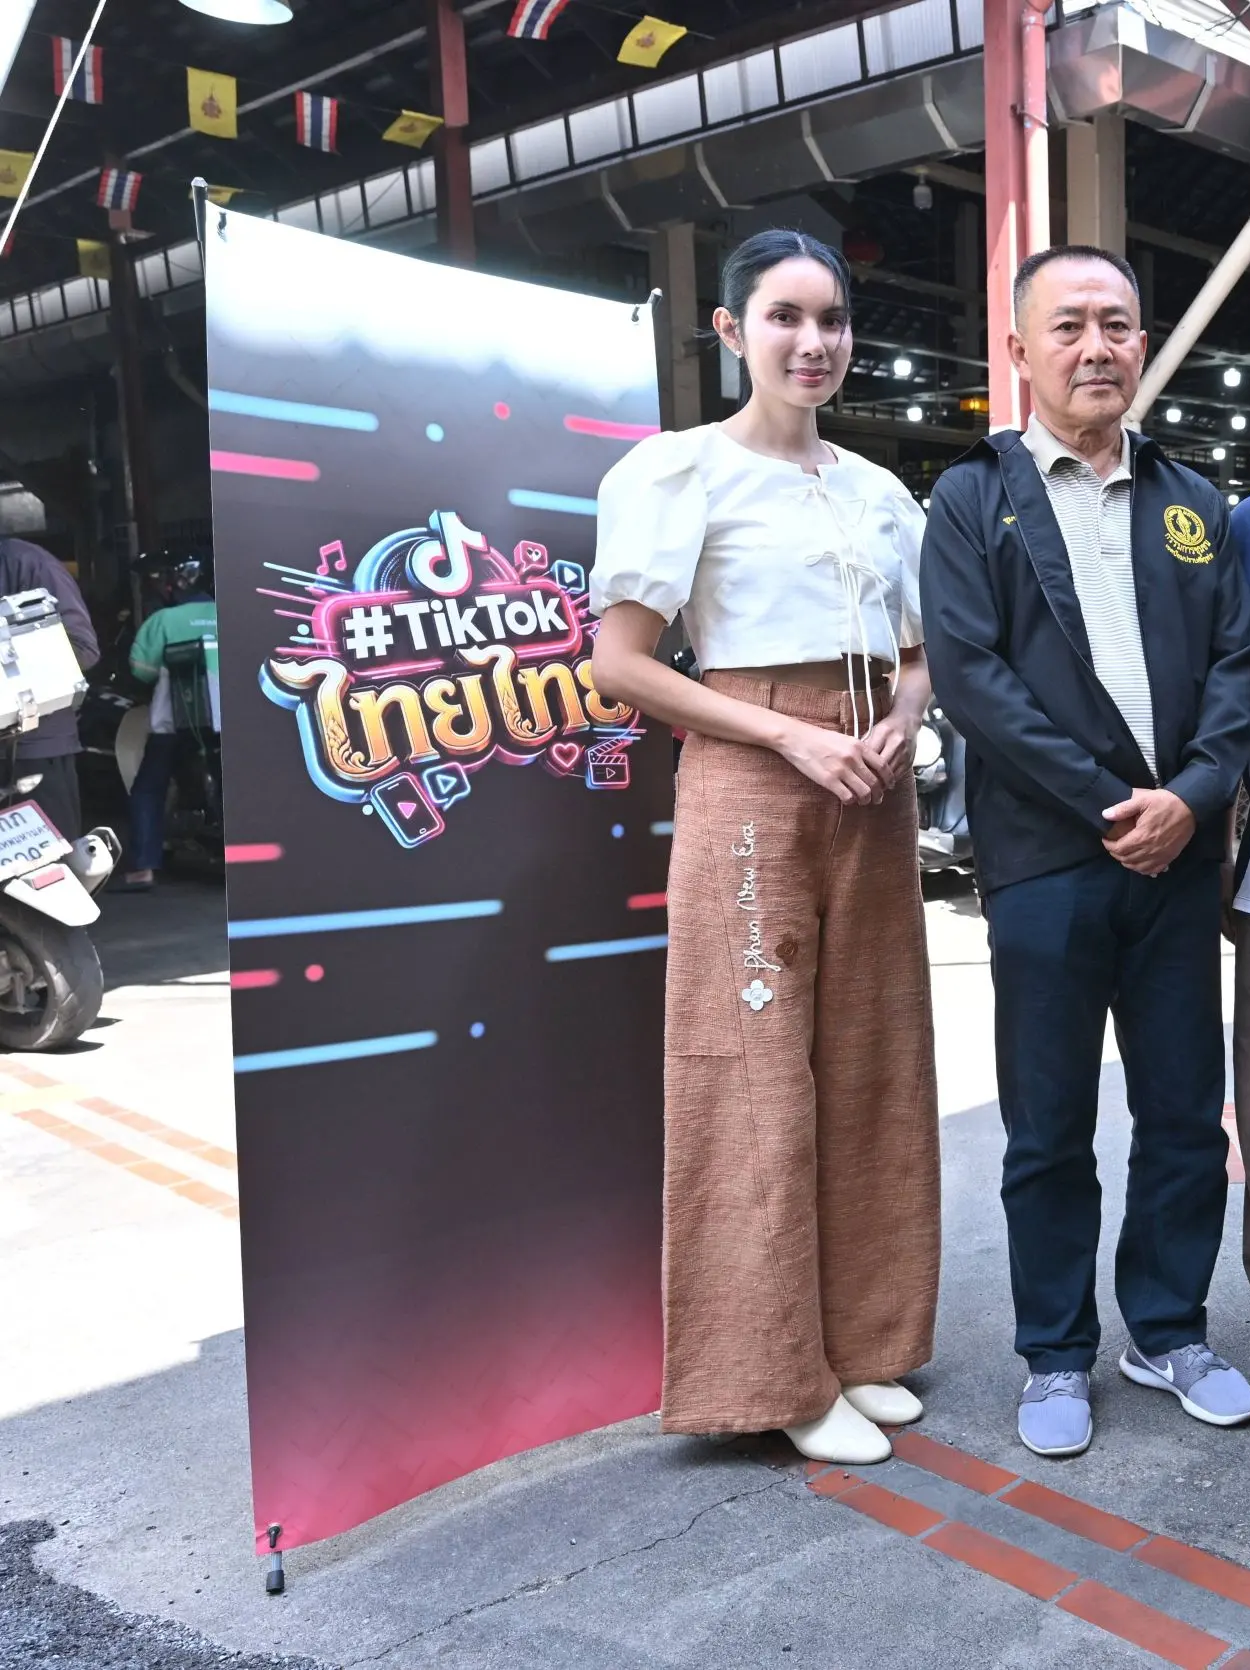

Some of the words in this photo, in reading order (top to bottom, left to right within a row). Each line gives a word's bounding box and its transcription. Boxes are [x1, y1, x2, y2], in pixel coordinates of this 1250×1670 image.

[344, 590, 569, 659] #TikTok
[732, 820, 754, 857] Era
[737, 868, 757, 911] New
